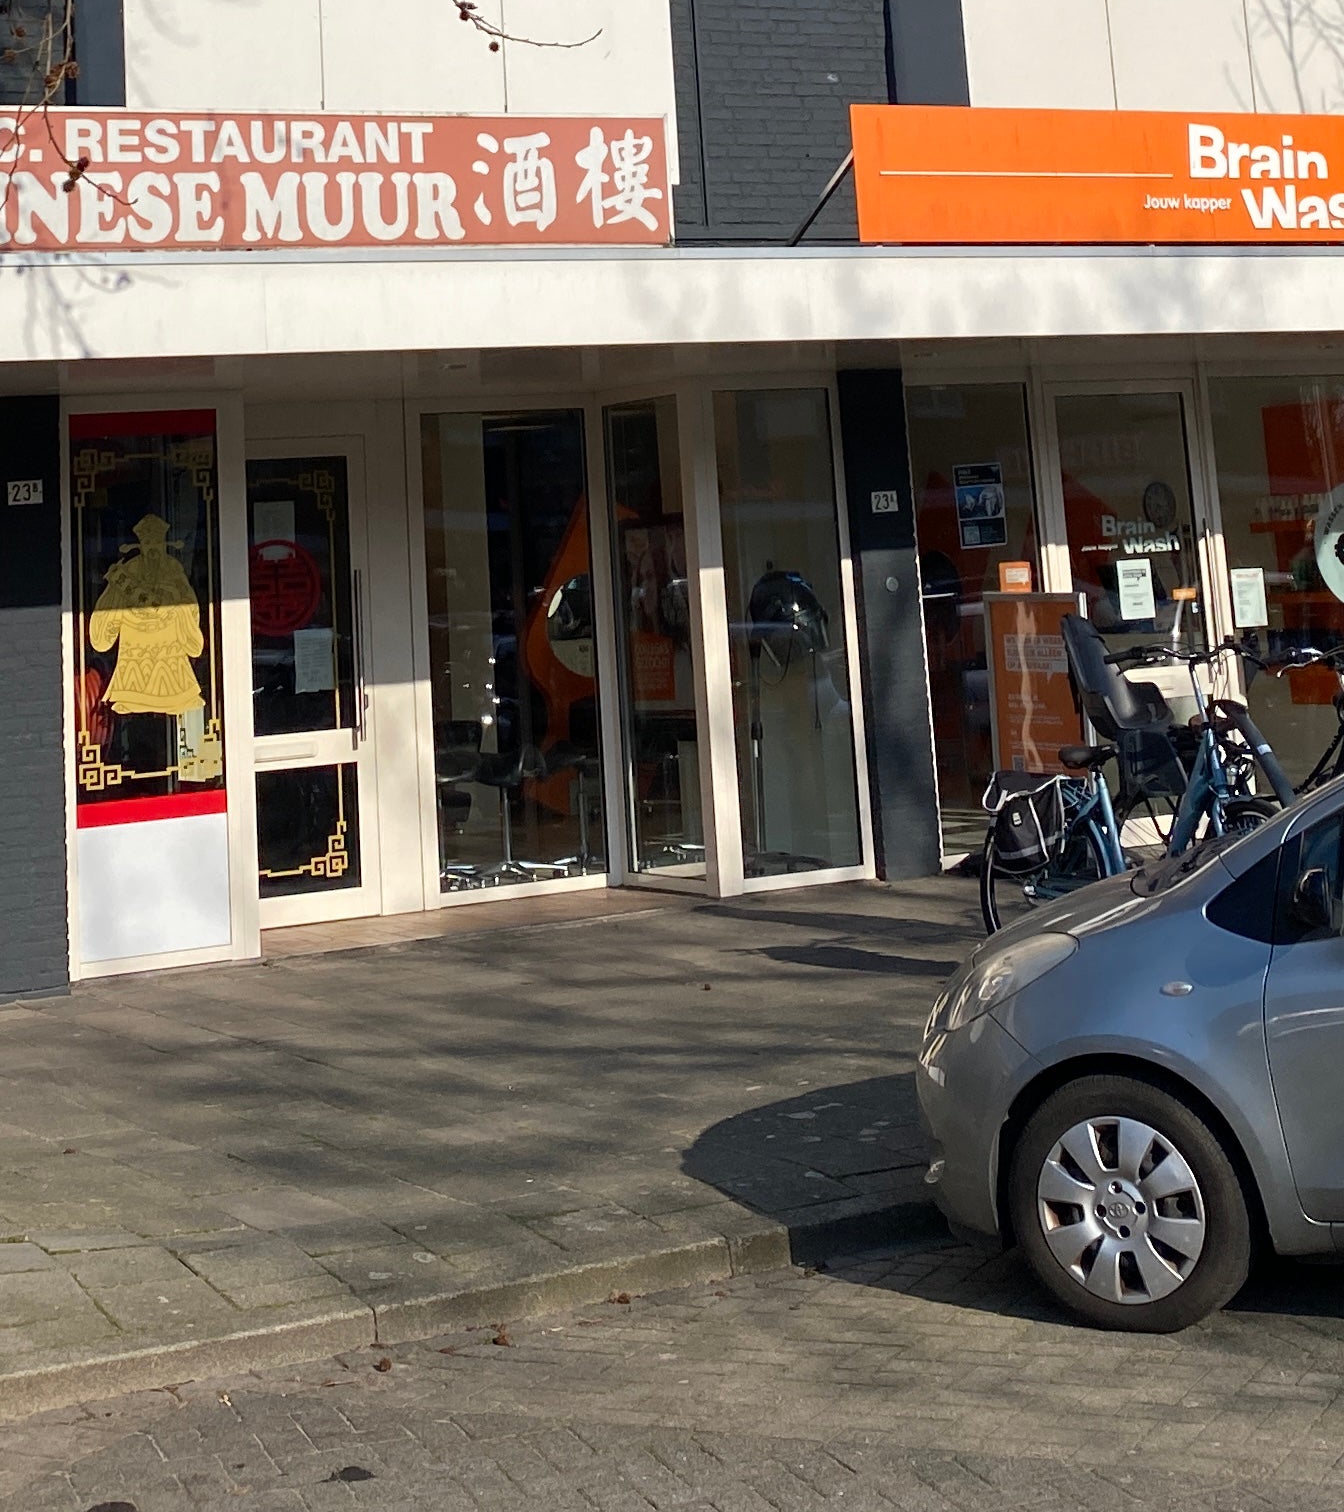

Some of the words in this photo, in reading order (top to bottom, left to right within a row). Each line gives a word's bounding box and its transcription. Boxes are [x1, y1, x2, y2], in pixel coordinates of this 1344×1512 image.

[66, 117, 434, 165] RESTAURANT
[1188, 122, 1329, 180] Brain
[240, 171, 466, 242] MUUR
[1143, 194, 1181, 210] Jouw
[1184, 193, 1233, 214] kapper
[1101, 514, 1156, 537] Brain
[1123, 530, 1181, 555] Wash
